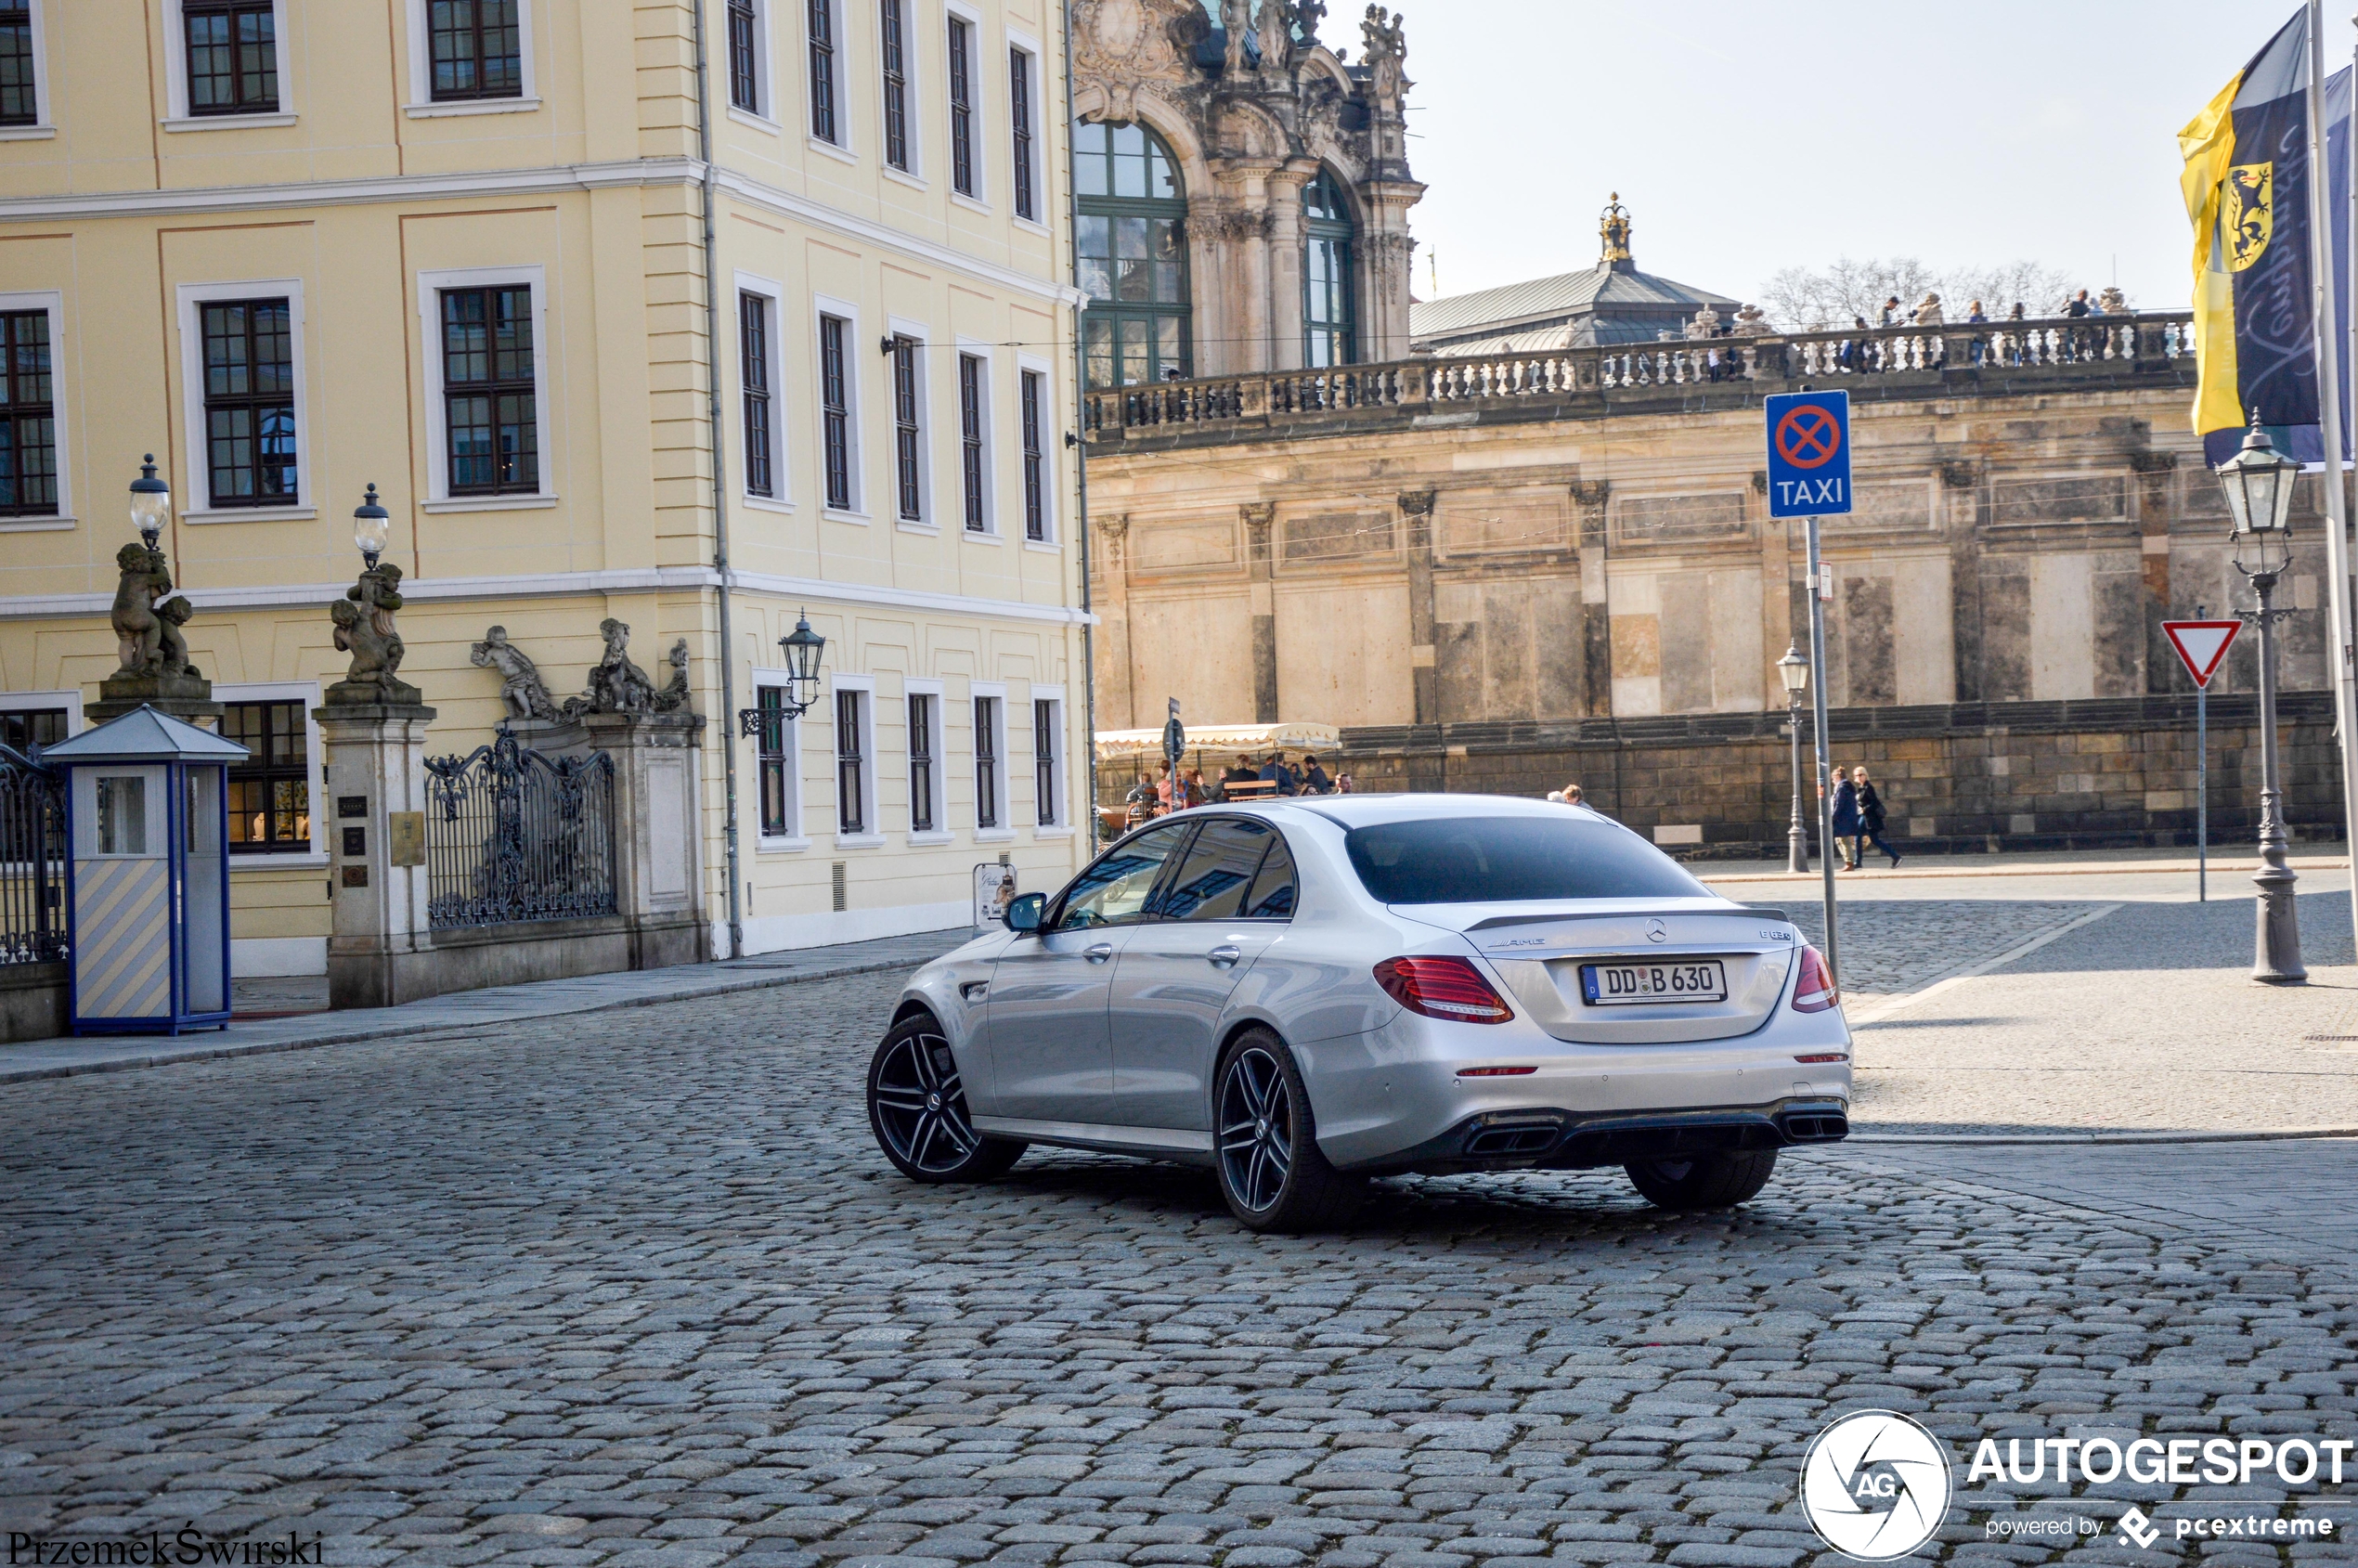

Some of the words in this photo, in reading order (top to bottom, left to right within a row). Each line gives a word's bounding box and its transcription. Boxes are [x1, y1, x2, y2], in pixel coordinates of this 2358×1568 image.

[1777, 478, 1843, 506] TAXI
[1589, 986, 1596, 994] D
[1606, 969, 1637, 993] DD
[1651, 968, 1666, 992] B
[1672, 966, 1713, 991] 630
